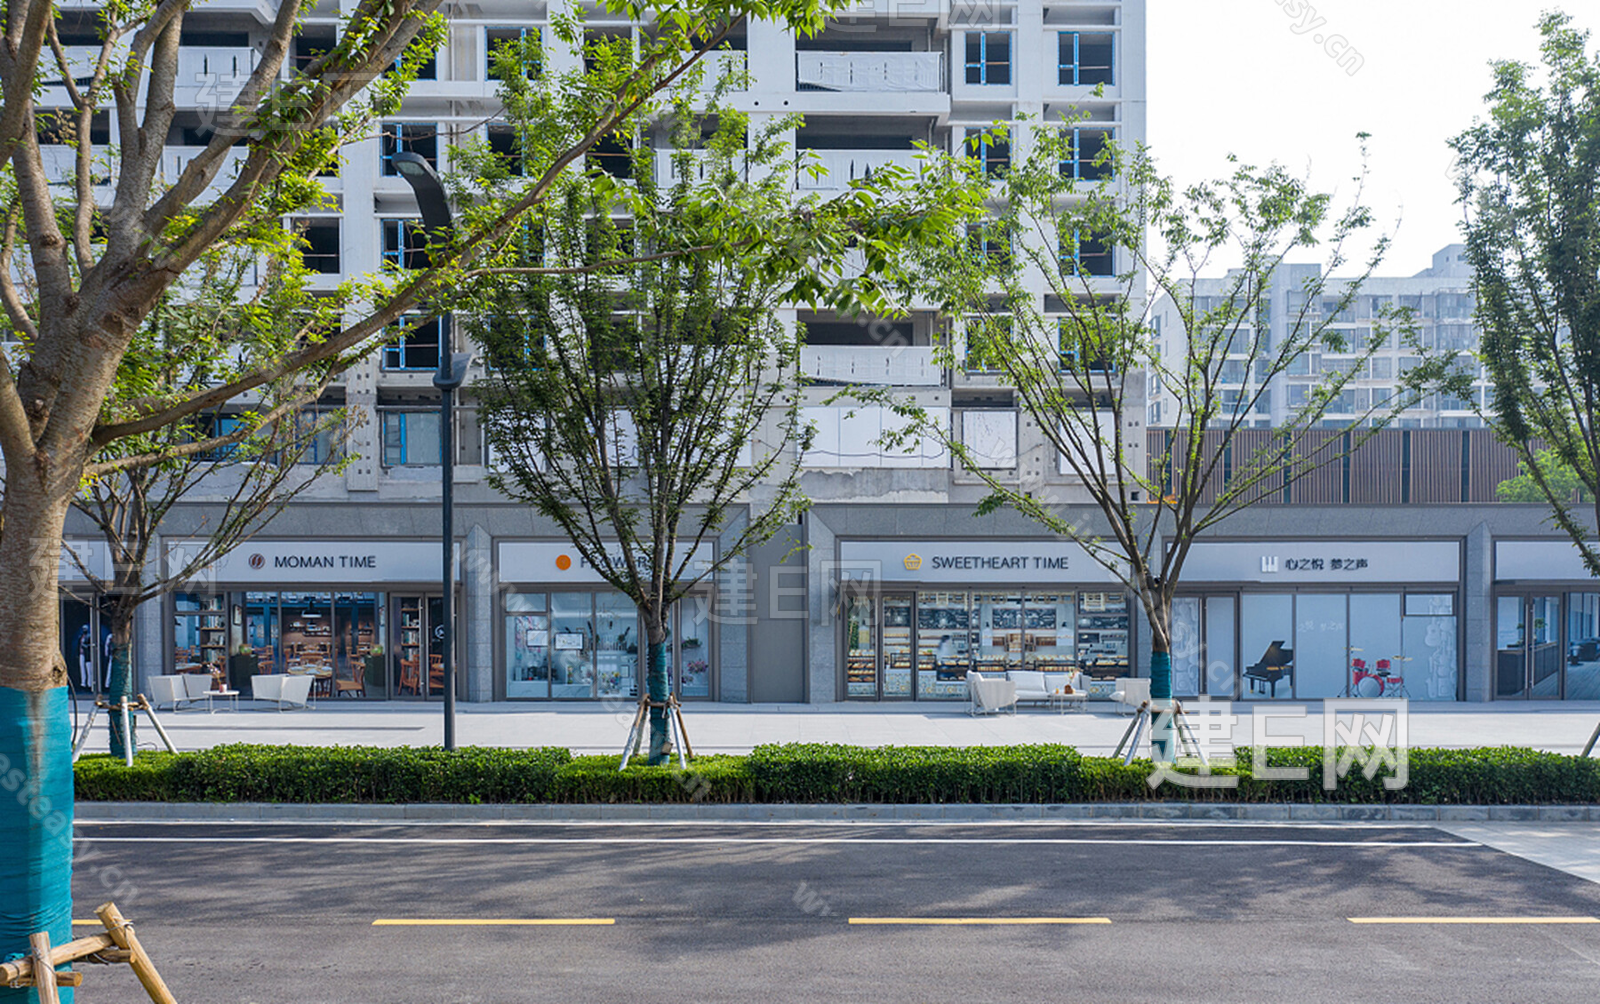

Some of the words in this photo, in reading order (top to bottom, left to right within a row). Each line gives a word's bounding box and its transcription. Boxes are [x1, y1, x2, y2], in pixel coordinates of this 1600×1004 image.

[274, 555, 335, 569] MOMAN
[339, 555, 376, 568] TIME
[931, 556, 1029, 569] SWEETHEART
[1033, 556, 1069, 569] TIME
[1285, 558, 1324, 570] 心之悦
[1330, 558, 1368, 570] 梦之声
